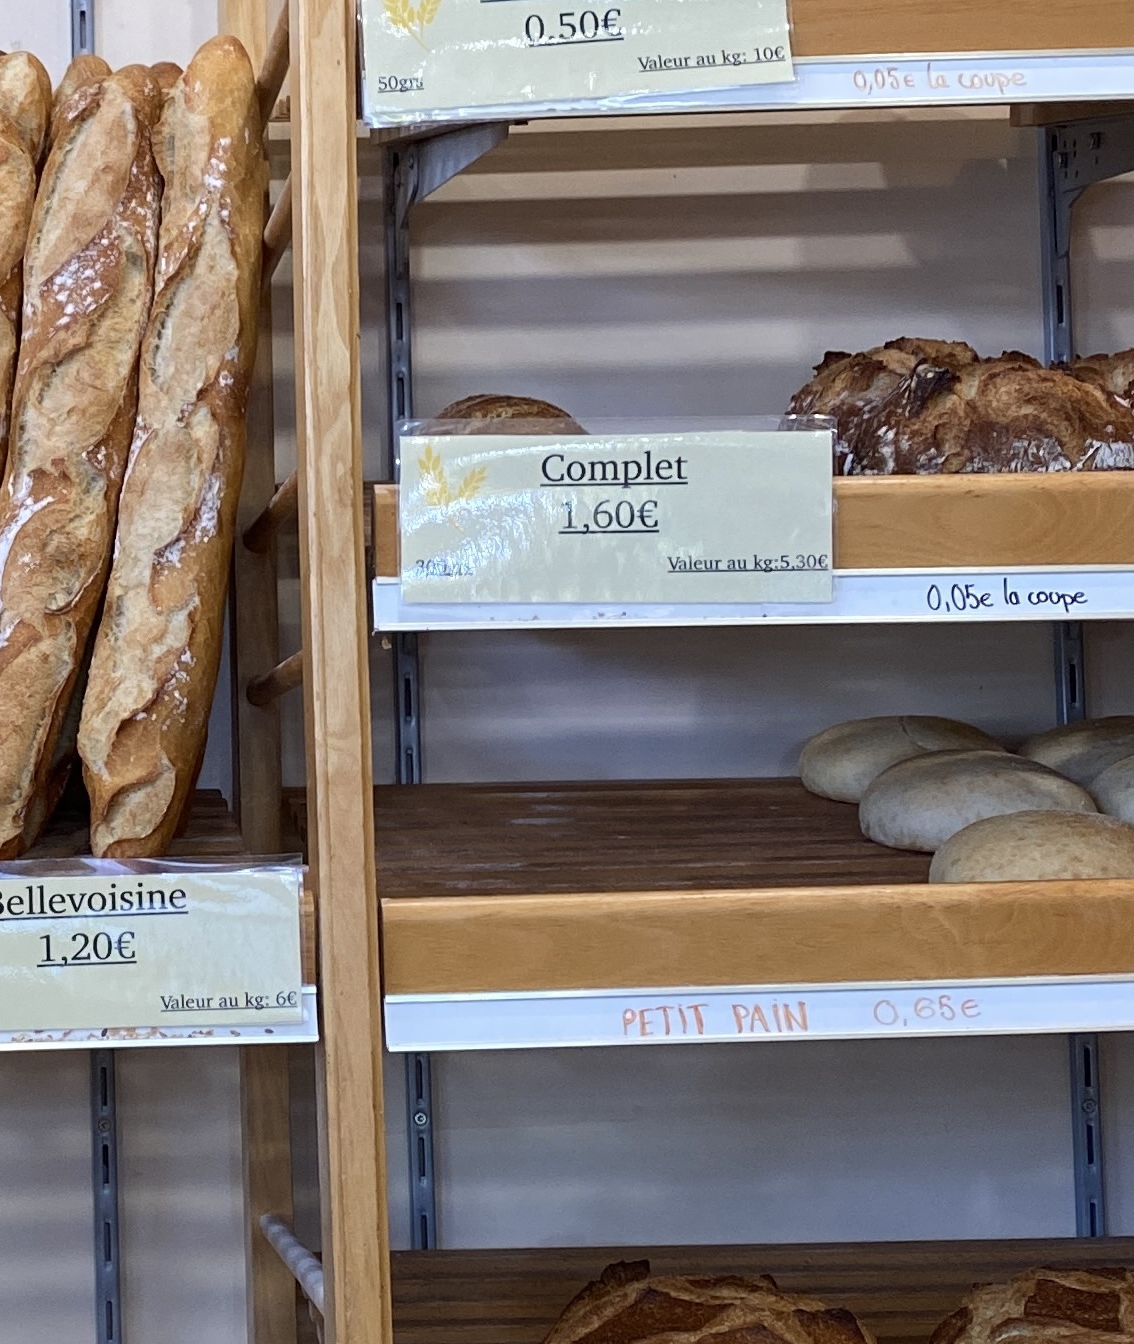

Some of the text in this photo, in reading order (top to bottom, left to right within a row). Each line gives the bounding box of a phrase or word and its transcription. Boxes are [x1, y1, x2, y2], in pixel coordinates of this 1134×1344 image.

[637, 46, 785, 71] Valeur au kg: 10€
[927, 62, 950, 89] la
[958, 71, 1027, 95] coupe
[541, 450, 688, 489] Complet
[562, 500, 659, 534] 1,60€
[667, 555, 723, 571] Valeur
[727, 558, 747, 571] au
[1003, 577, 1020, 605] la
[1028, 591, 1088, 613] coupe
[39, 931, 137, 966] 1,20€
[160, 990, 297, 1011] Valeur au kg: 6€
